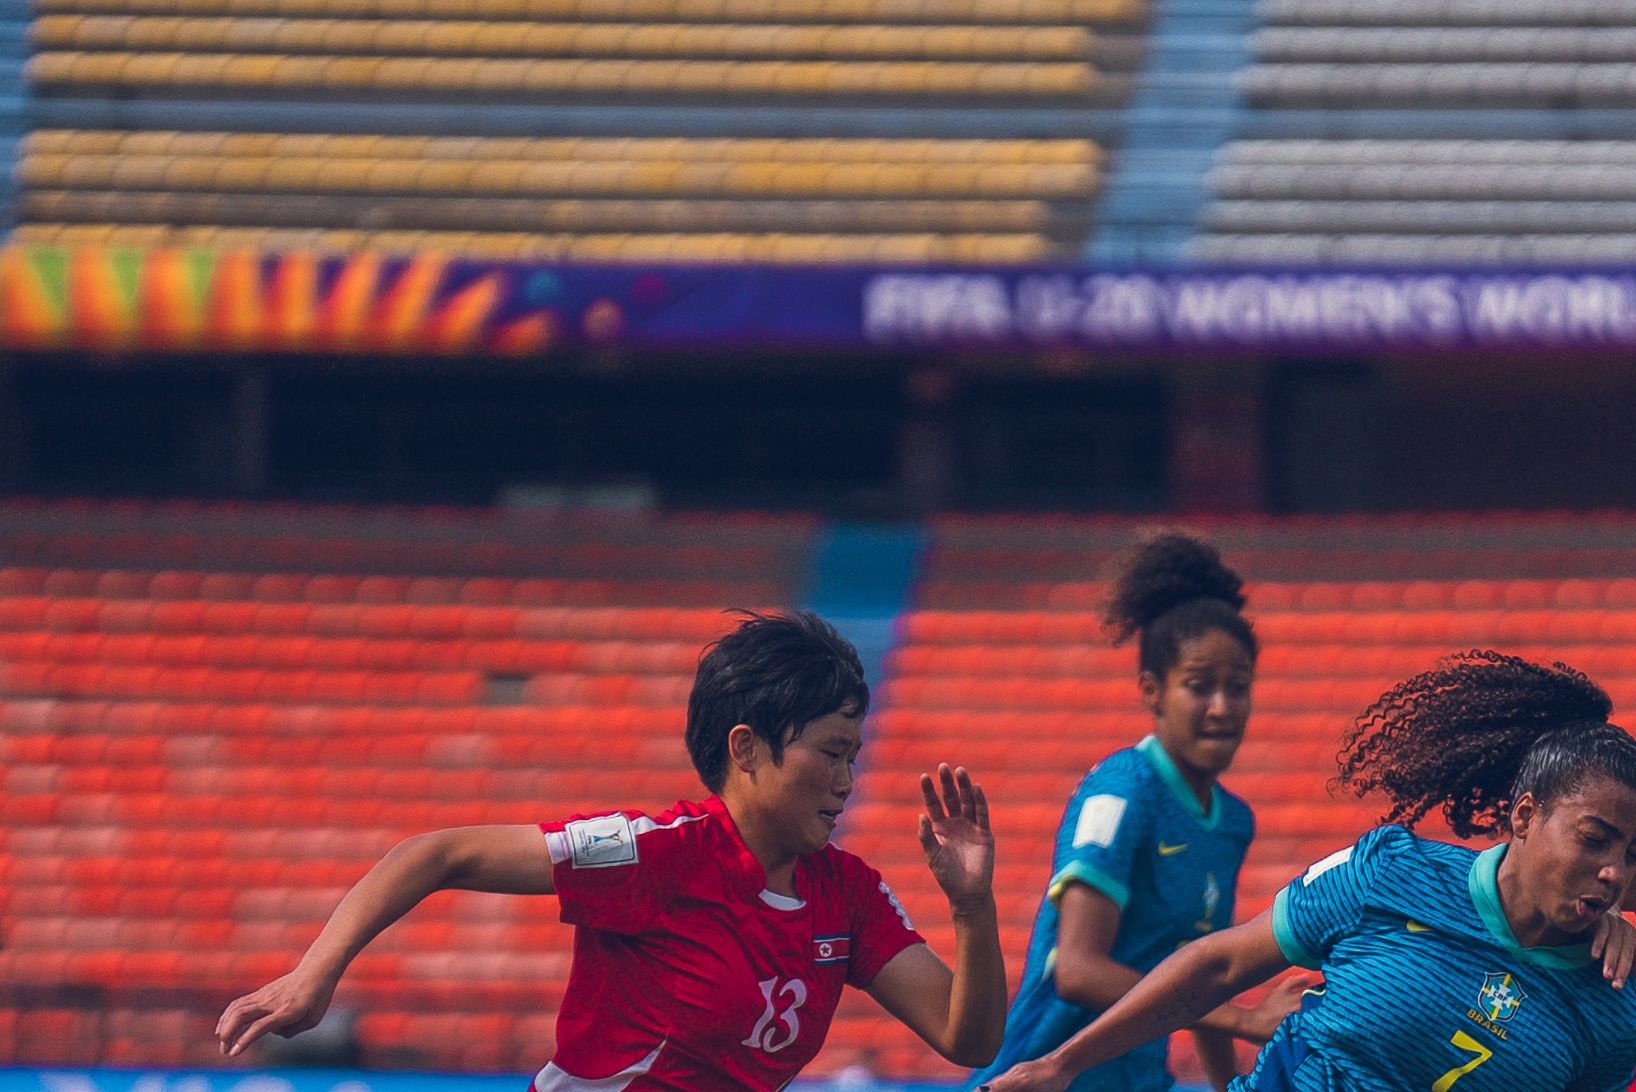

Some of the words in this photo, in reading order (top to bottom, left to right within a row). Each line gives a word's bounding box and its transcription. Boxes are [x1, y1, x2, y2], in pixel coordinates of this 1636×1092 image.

[864, 274, 1006, 335] FIFA
[1171, 274, 1459, 335] WOMEN'S
[740, 976, 807, 1053] 13
[1466, 1008, 1509, 1040] BRASIL
